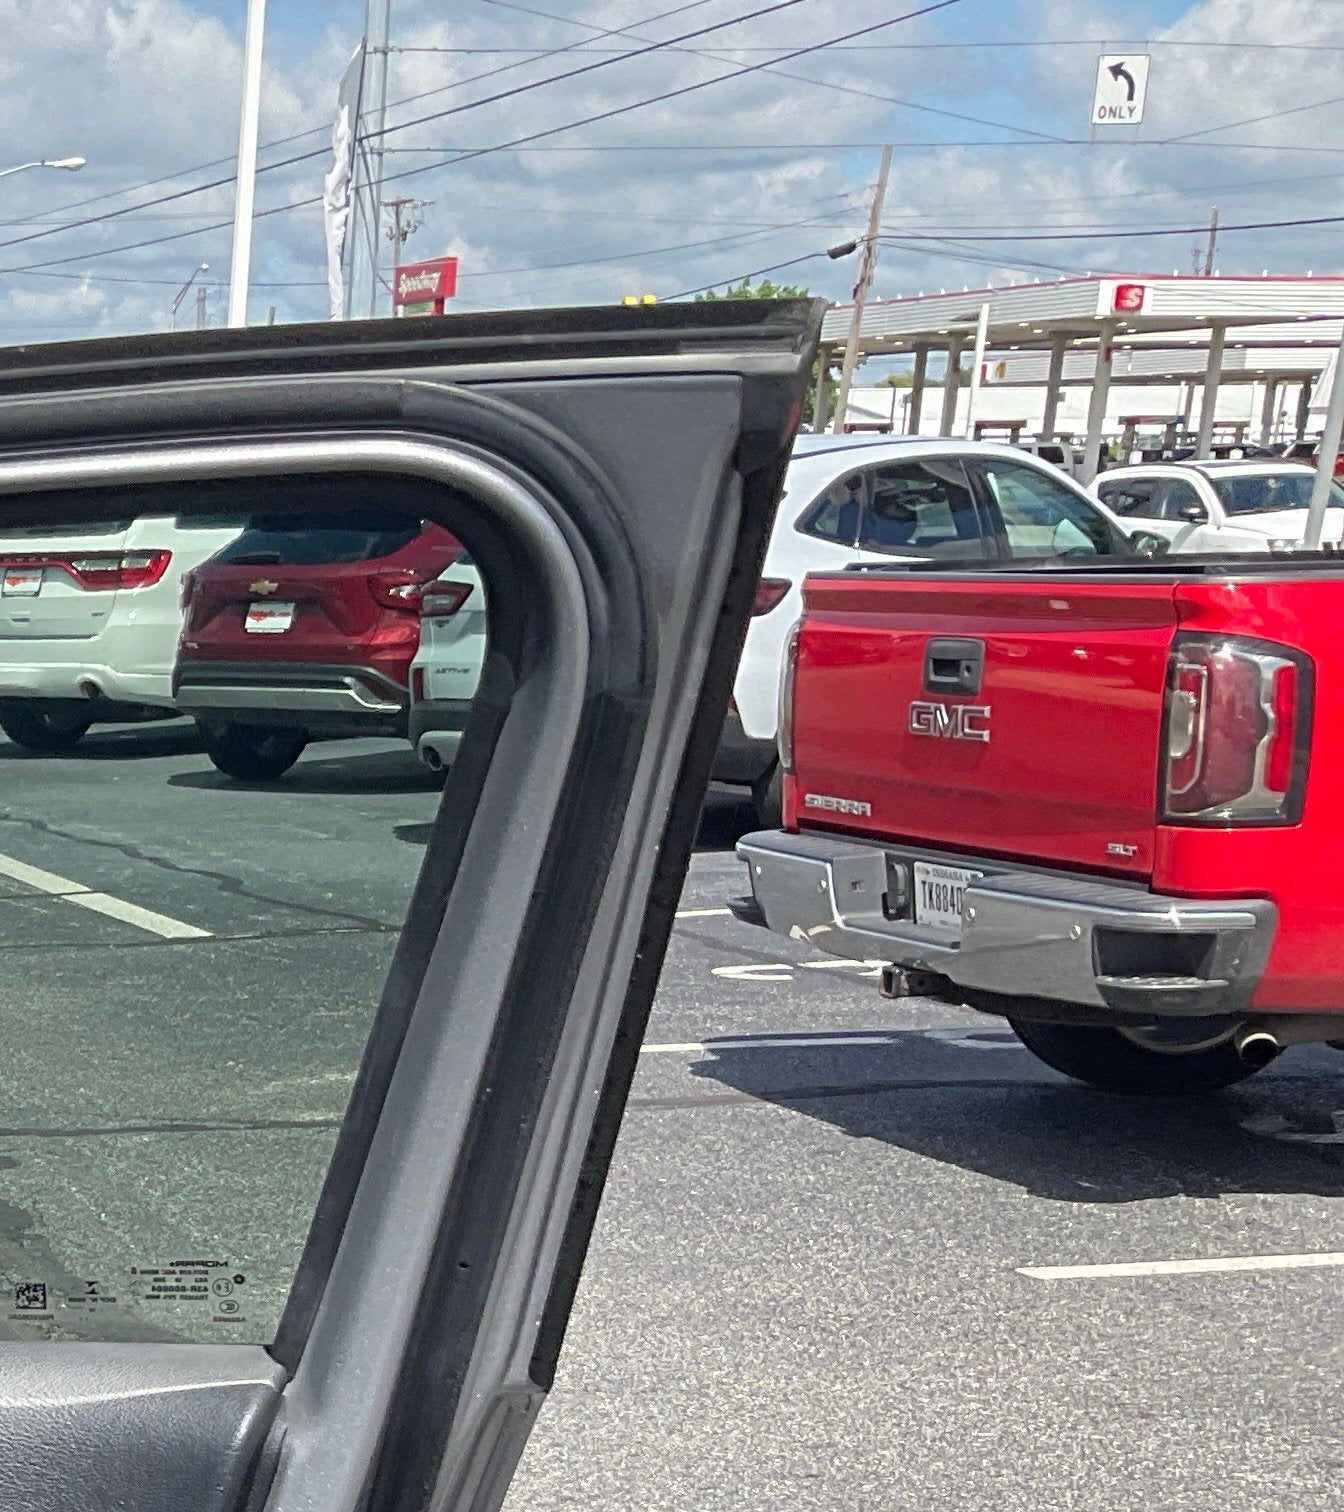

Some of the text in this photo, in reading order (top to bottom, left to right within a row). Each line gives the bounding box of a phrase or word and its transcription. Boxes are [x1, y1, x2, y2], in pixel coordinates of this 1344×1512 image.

[1098, 105, 1137, 119] ONLY
[908, 700, 992, 743] GMC
[805, 793, 871, 817] SIERRA
[1106, 843, 1138, 857] SLT
